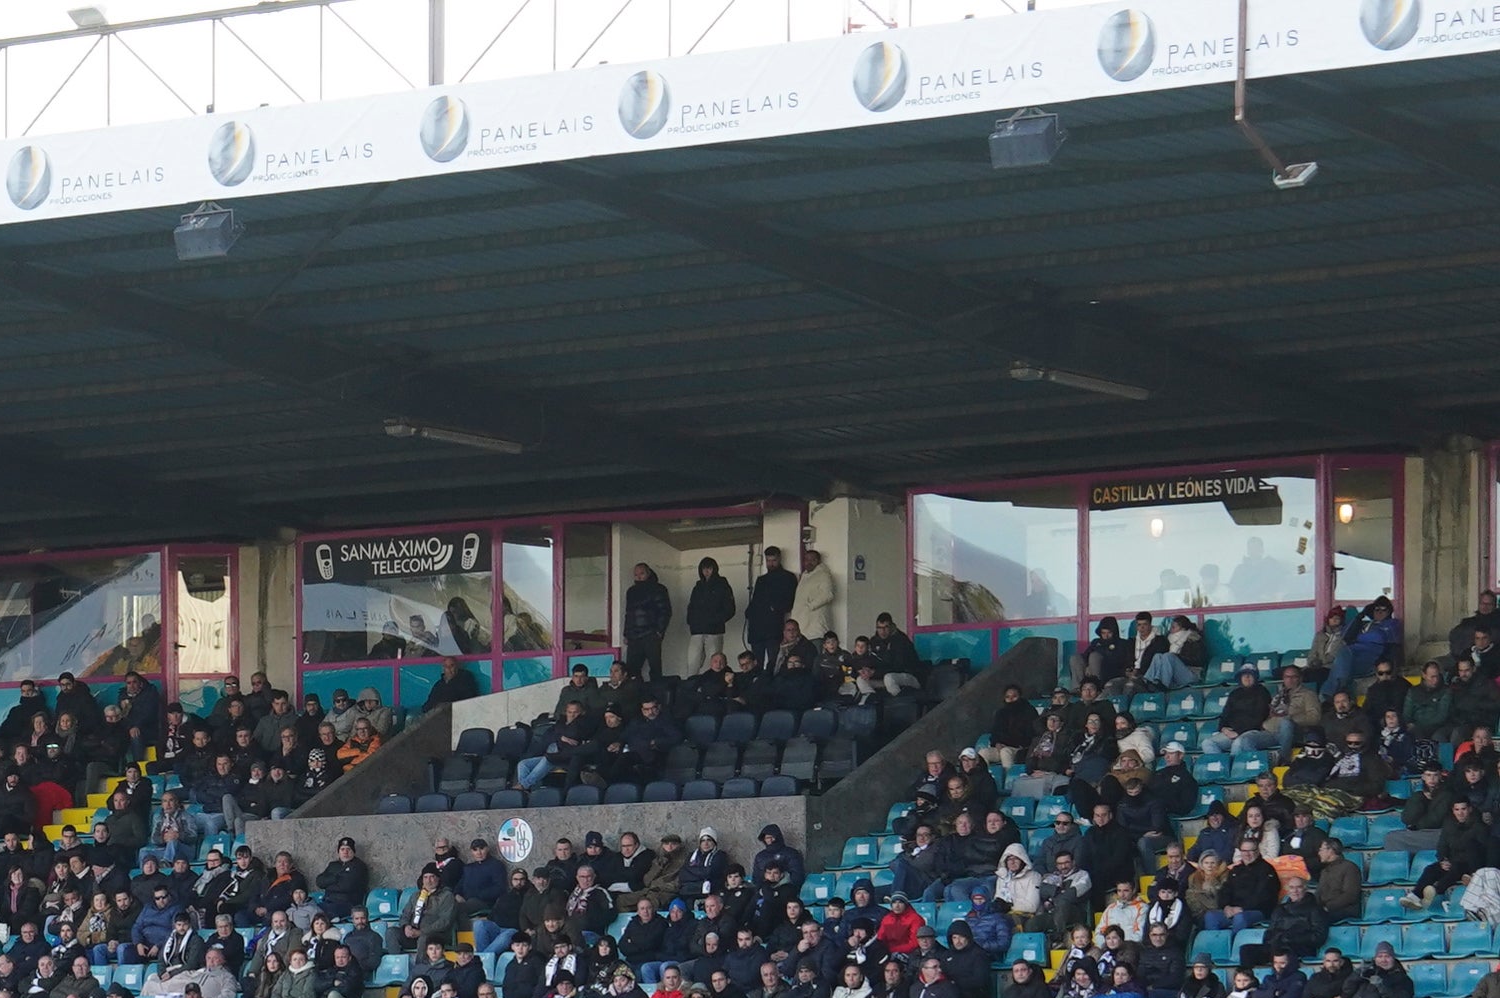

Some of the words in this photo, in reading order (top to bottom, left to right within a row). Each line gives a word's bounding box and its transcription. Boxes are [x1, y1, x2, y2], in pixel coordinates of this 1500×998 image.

[919, 61, 1044, 95] PANELAIS
[1151, 60, 1234, 75] PRODUCCIONES
[681, 92, 800, 123] PANELAIS
[481, 116, 594, 147] PANELAIS
[266, 142, 374, 172] PANELAIS
[62, 167, 166, 196] PANELAIS
[1093, 481, 1155, 504] CASTILLA
[1157, 481, 1166, 499] Y
[1225, 476, 1256, 495] VIDA
[340, 537, 442, 562] SANMÁXIMO
[371, 556, 433, 576] TELECOM
[303, 652, 310, 664] 2
